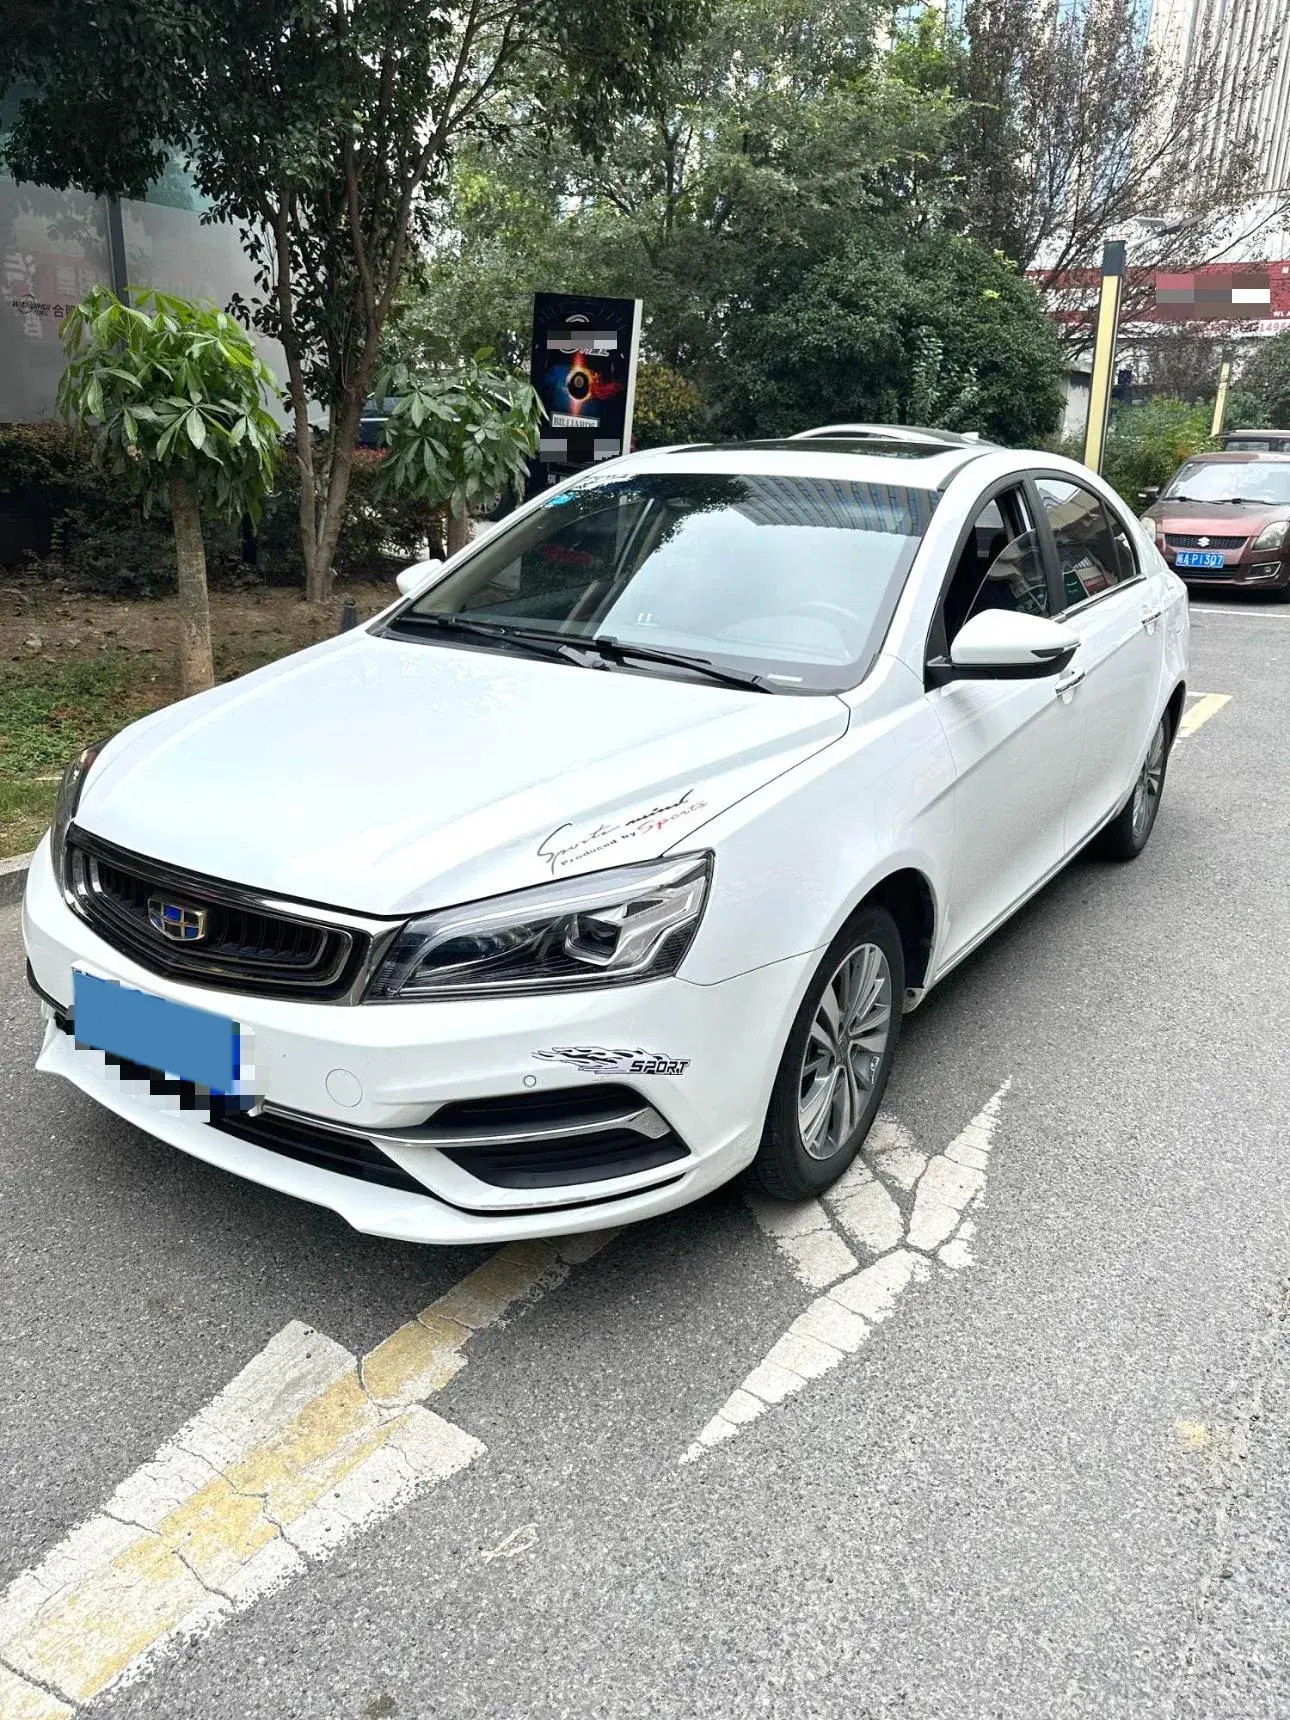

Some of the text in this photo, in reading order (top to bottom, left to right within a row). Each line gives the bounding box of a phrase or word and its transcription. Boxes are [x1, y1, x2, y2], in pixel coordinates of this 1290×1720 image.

[624, 788, 694, 827] mind
[560, 838, 618, 866] Produced
[620, 831, 637, 840] by
